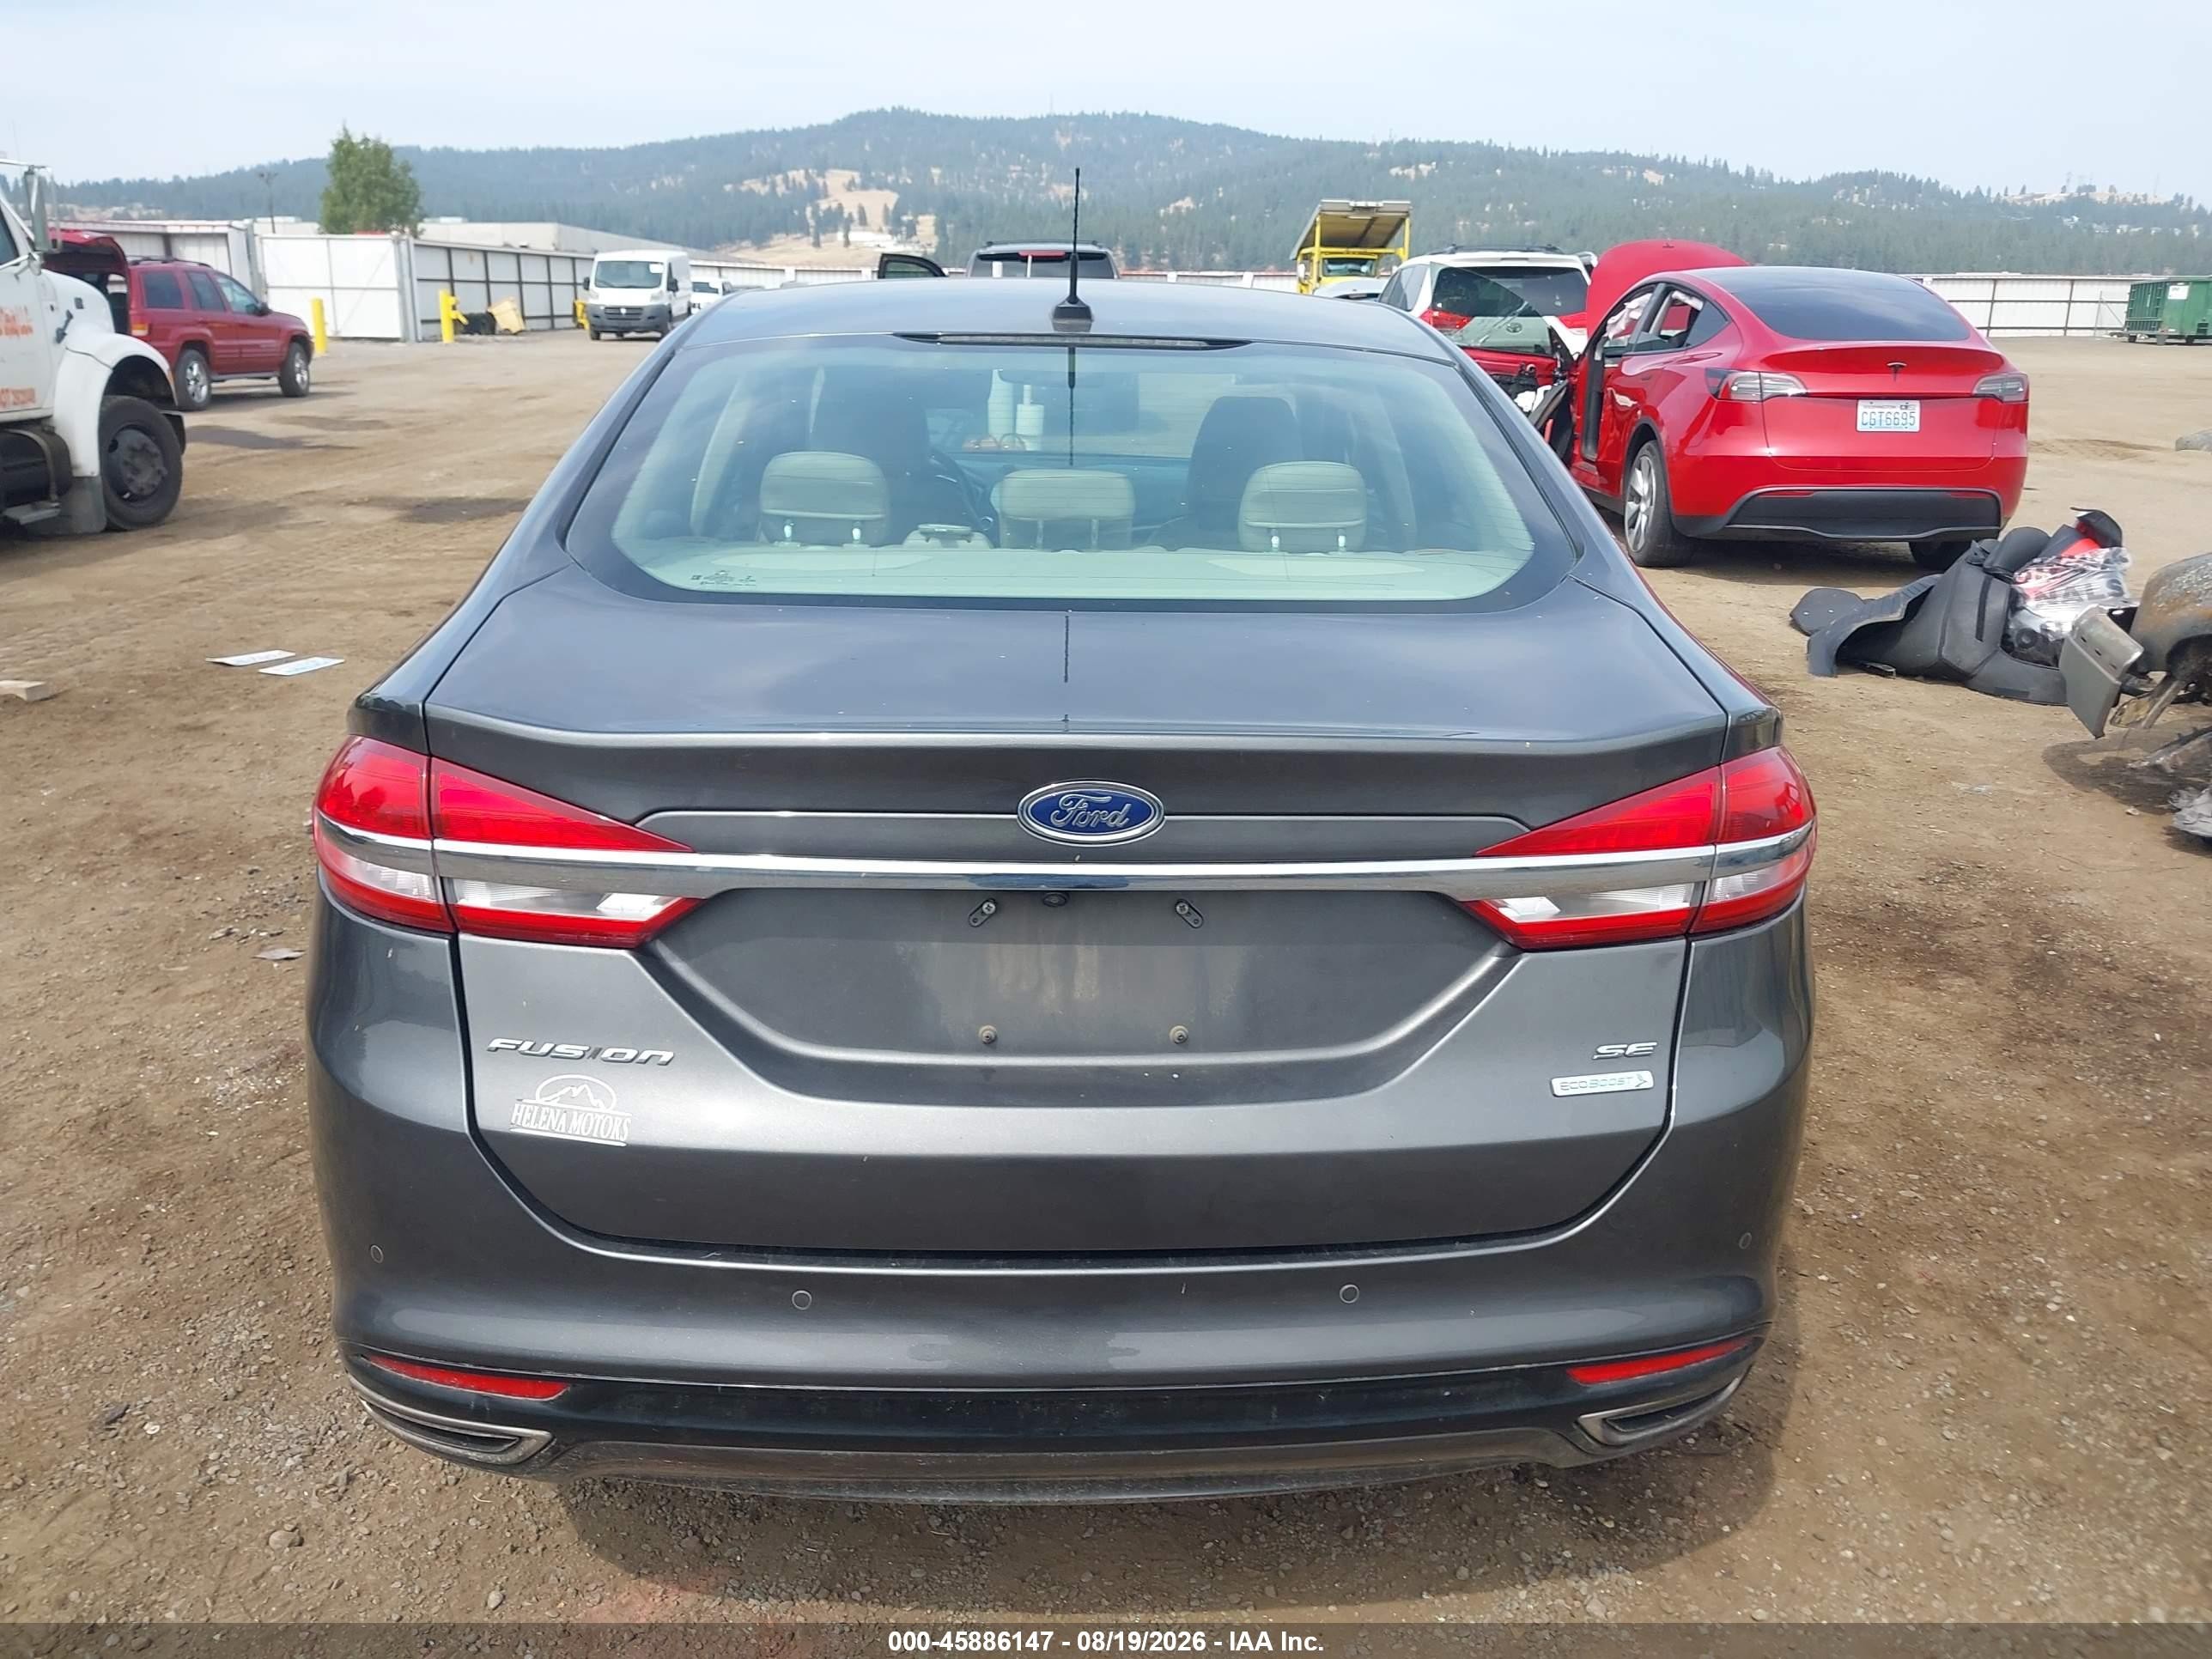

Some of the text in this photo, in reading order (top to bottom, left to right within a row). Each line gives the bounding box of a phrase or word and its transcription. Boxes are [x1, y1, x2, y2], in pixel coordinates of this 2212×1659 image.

[1861, 410, 1917, 427] CGT6695
[1049, 793, 1133, 829] Ford
[486, 1037, 675, 1066] FUSION
[1591, 1042, 1659, 1060] SE
[1559, 1077, 1634, 1091] ECOBOOST
[511, 1103, 633, 1142] HELENA MOTORS
